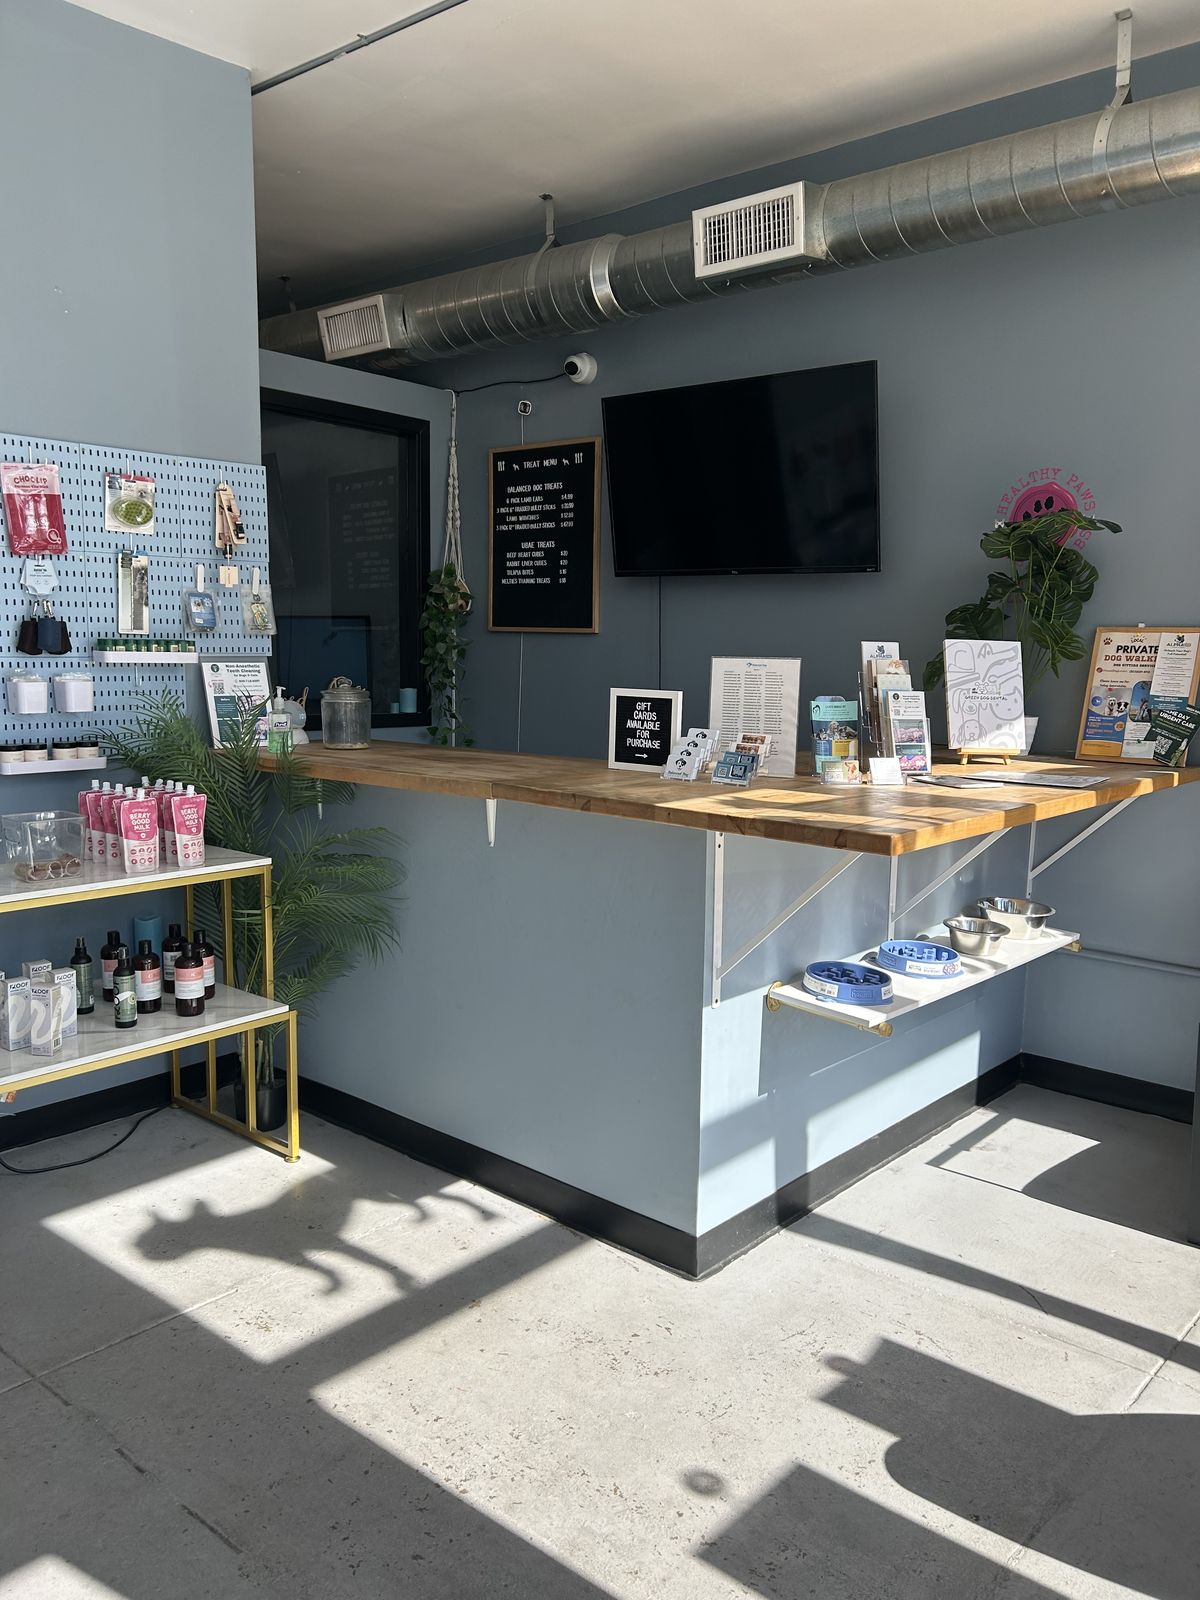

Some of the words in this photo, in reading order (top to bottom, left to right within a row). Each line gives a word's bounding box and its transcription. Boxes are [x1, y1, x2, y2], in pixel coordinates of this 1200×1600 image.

[523, 461, 540, 469] TREAT
[543, 459, 558, 467] MENU
[507, 485, 531, 493] BALANCED
[544, 482, 563, 490] TREATS
[996, 467, 1062, 515] HEALTHY
[1066, 473, 1096, 512] PAWS
[536, 541, 555, 549] TREATS
[1115, 645, 1159, 654] PRIVATE
[636, 702, 651, 711] GIFT
[633, 711, 657, 721] CARDS
[1159, 711, 1182, 724] URGENT
[1181, 720, 1197, 729] CARE
[1177, 713, 1191, 721] DAY
[626, 719, 660, 730] AVAILABLE
[636, 730, 650, 738] FOR
[626, 738, 660, 749] PURCHASE
[129, 812, 151, 820] BERRY
[131, 818, 151, 826] GOOD
